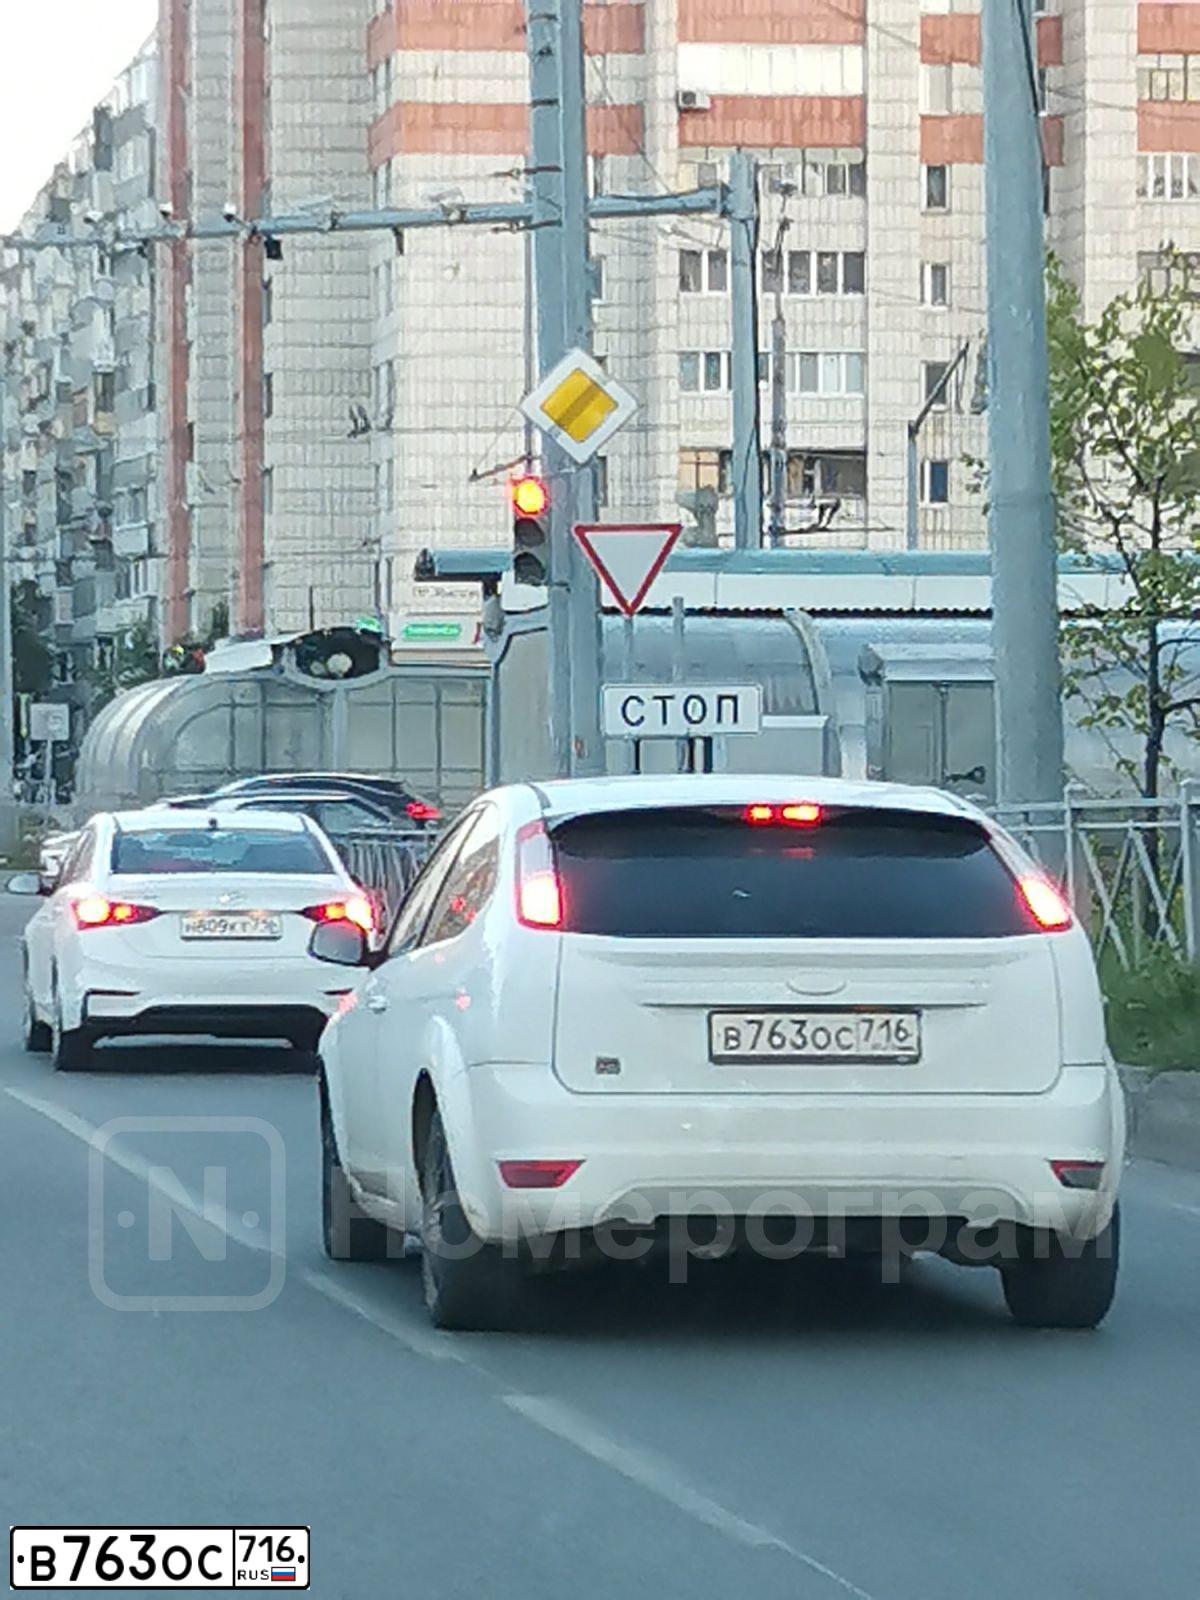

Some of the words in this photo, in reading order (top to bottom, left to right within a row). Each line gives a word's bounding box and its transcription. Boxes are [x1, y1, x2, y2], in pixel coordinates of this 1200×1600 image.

[621, 694, 739, 727] СТОП
[724, 1019, 854, 1051] В763ОС
[860, 1018, 909, 1042] 716
